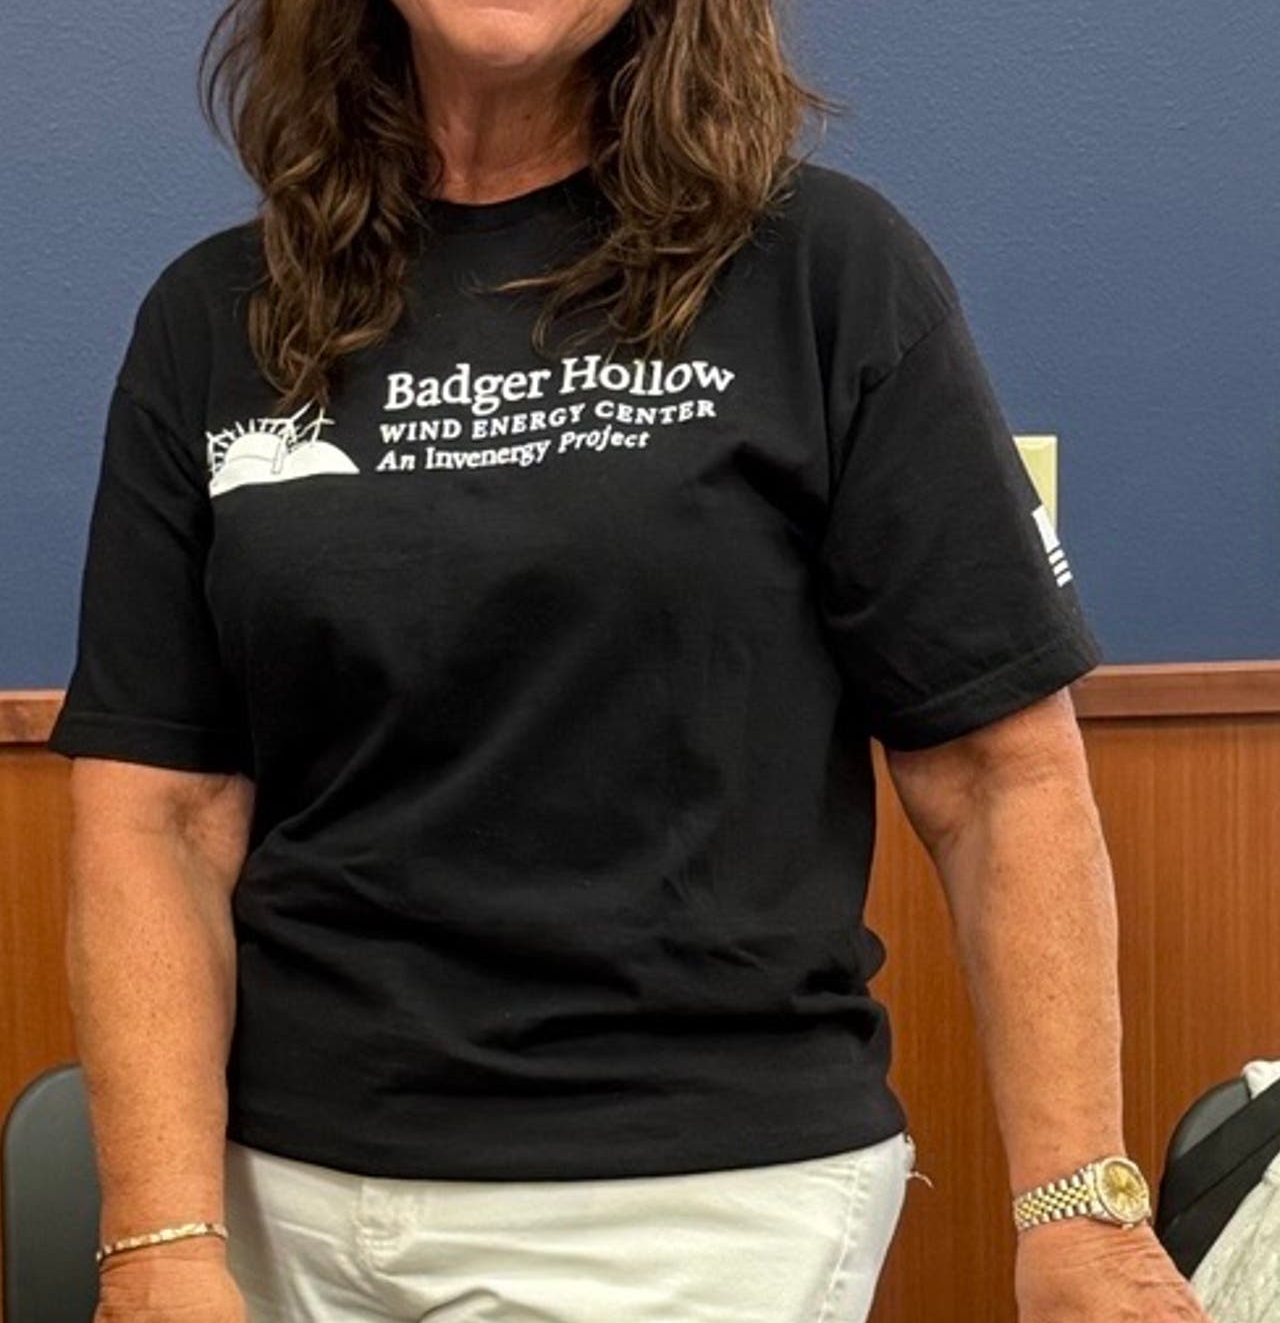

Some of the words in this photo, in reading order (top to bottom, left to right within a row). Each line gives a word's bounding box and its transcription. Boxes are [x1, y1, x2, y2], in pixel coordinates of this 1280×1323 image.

[384, 363, 552, 416] Badger
[558, 355, 736, 397] Hollow
[379, 420, 463, 445] WIND
[471, 403, 585, 440] ENERGY
[594, 400, 718, 425] CENTER
[376, 450, 415, 472] An
[425, 439, 552, 468] Invenergy
[558, 425, 650, 453] Project
